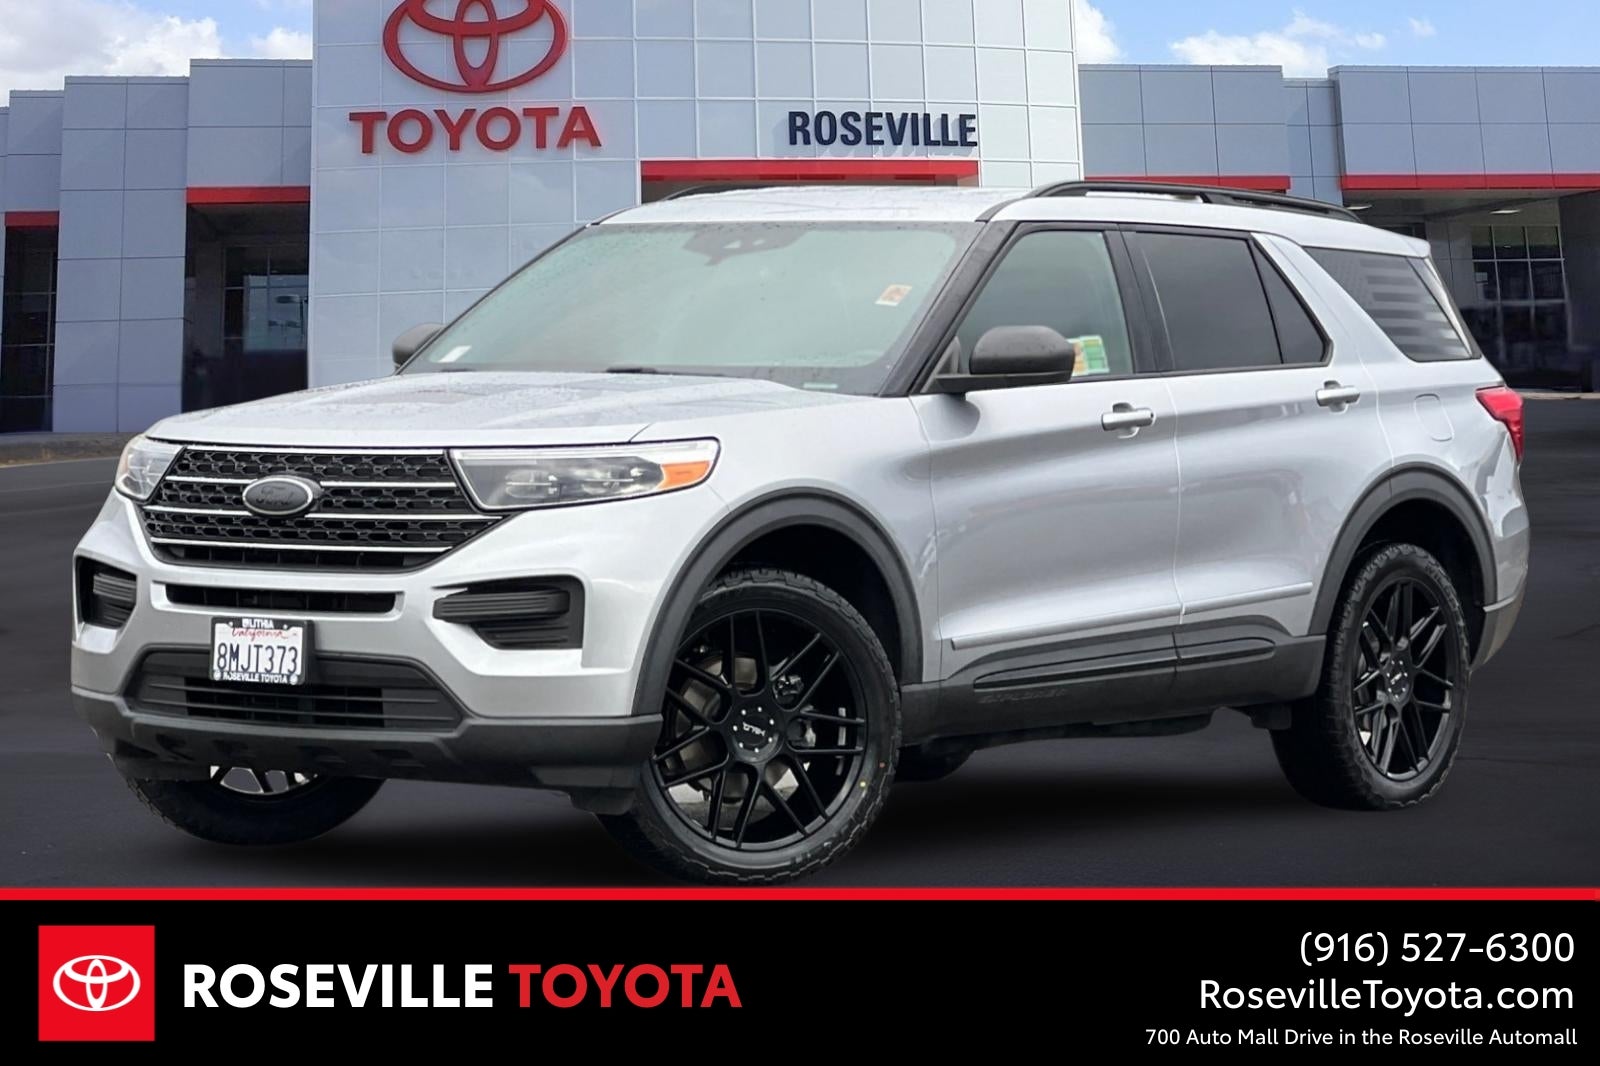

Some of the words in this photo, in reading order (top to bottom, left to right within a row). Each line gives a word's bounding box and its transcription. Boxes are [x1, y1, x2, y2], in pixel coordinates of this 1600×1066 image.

[349, 106, 602, 154] TOYOTA
[788, 110, 978, 147] ROSEVILLE
[232, 627, 283, 641] California
[217, 642, 298, 674] 8MJT373
[222, 672, 260, 682] ROSEVILLE
[261, 674, 288, 683] TOYOTA
